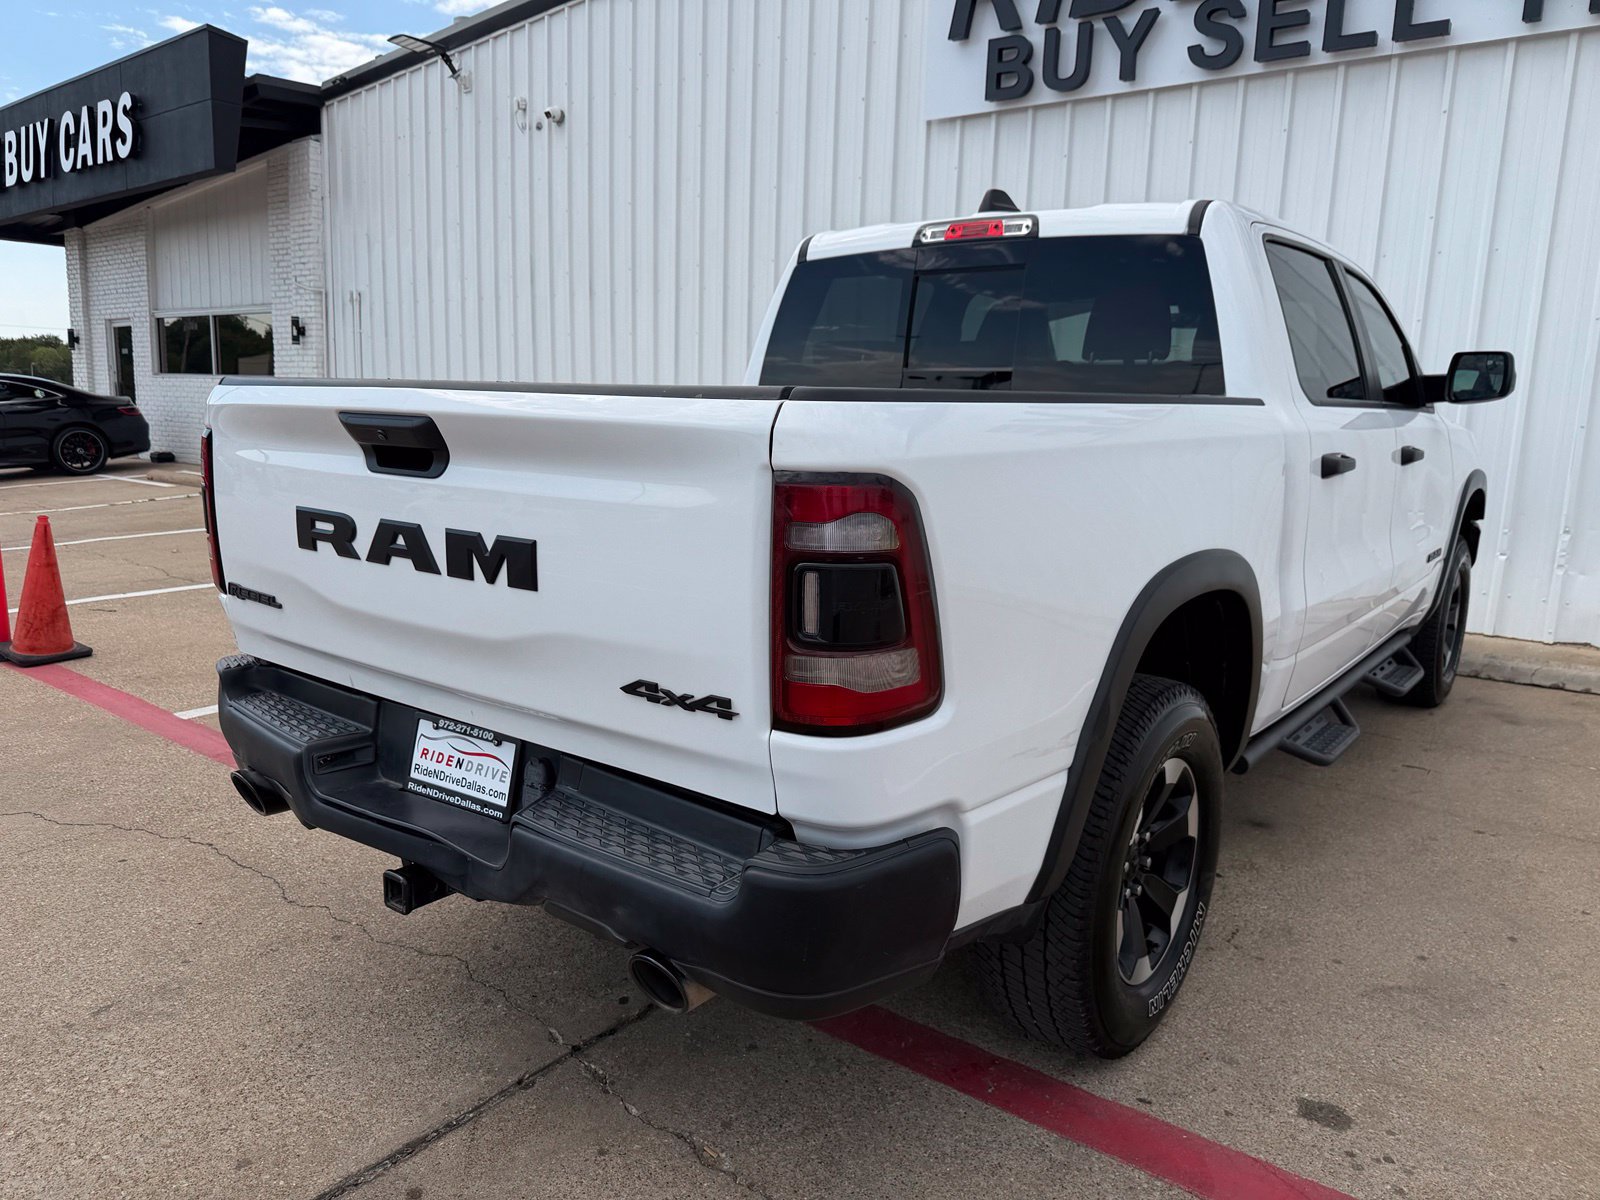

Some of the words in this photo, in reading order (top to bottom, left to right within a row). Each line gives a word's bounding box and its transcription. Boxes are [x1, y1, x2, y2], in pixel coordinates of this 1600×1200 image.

[985, 7, 1161, 102] BUY
[1187, 0, 1452, 70] SELL
[4, 117, 49, 187] BUY
[59, 91, 133, 173] CARS
[296, 506, 538, 592] RAM
[228, 581, 283, 609] REBEL
[438, 719, 494, 741] 972-271-5100
[407, 781, 503, 819] RideNDriveDallas.com
[413, 763, 507, 801] RideNDriveDallas.com
[1148, 901, 1206, 1017] MICHELIN
